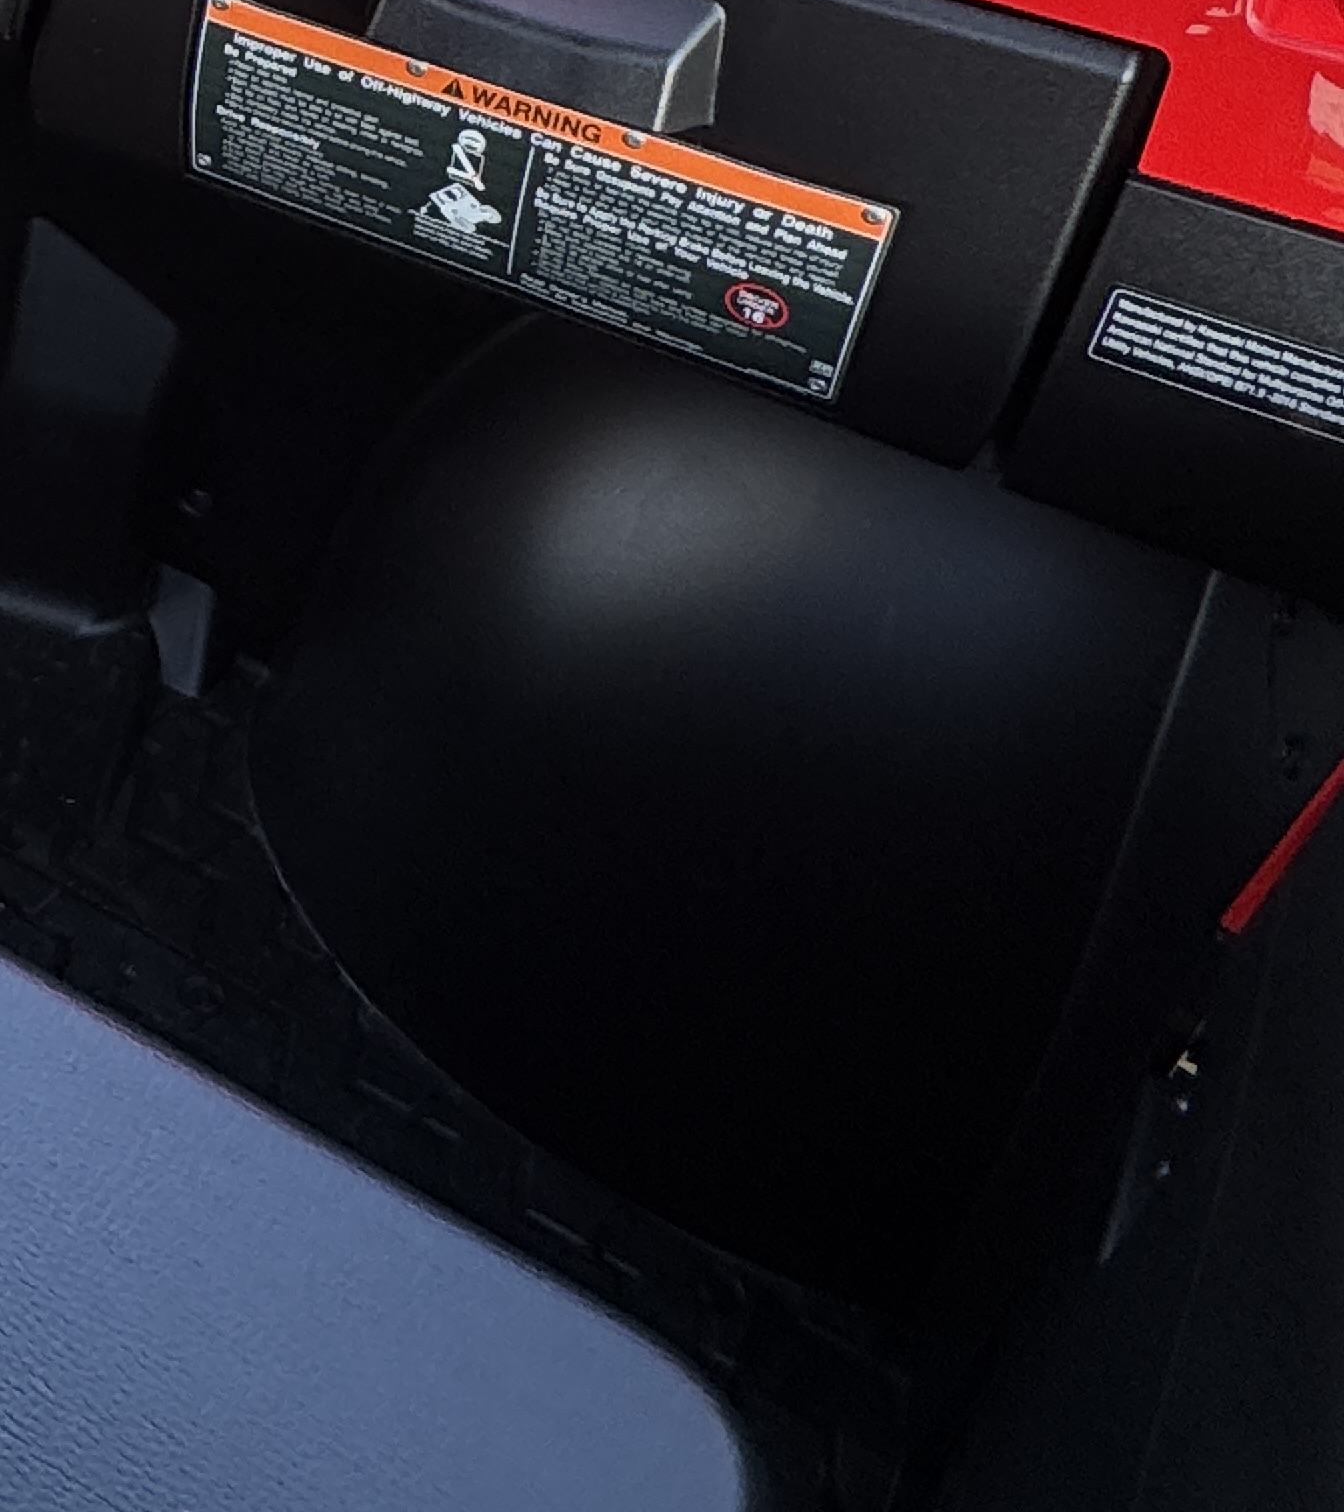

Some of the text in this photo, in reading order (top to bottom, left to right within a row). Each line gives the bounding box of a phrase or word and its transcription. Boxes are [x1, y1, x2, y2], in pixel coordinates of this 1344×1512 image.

[233, 33, 833, 241] Improper Use of Off-Highway Vehicles Can Cause Severe Injury or Death
[472, 85, 602, 144] WARNING
